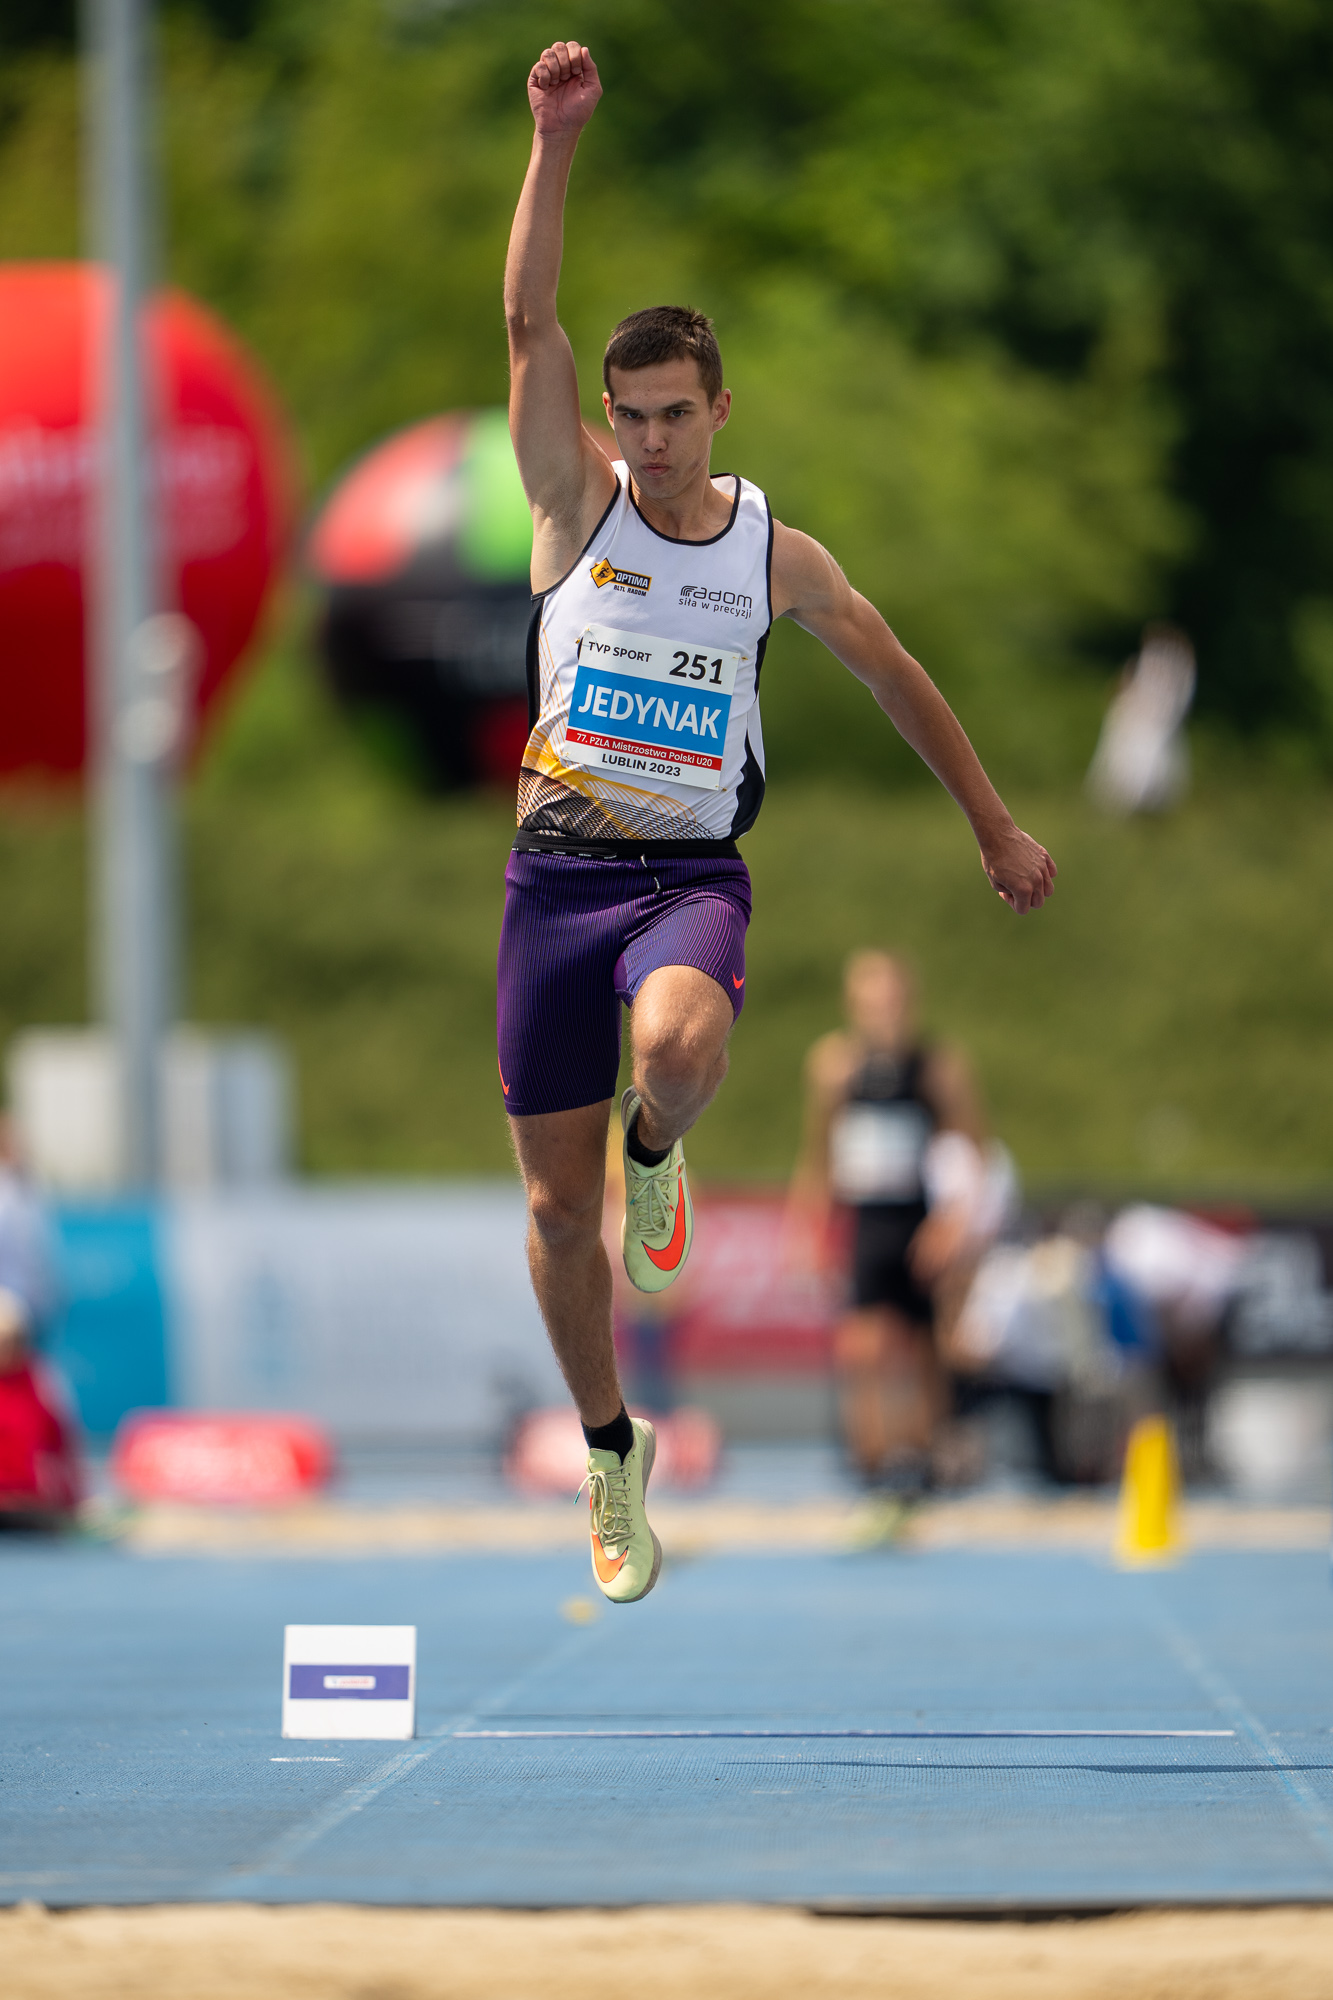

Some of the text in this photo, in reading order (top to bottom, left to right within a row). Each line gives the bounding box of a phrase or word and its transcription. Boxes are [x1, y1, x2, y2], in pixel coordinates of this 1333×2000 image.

[615, 572, 648, 588] OPTIMA
[627, 587, 647, 597] RADOM
[678, 597, 752, 619] siła w precyzji
[588, 641, 652, 663] TVP SPORT
[669, 651, 723, 685] 251
[578, 684, 722, 739] JEDYNAK
[576, 733, 713, 767] 77. PZLA Mistrzostwa Polski U20
[601, 753, 681, 777] LUBLIN 2023
